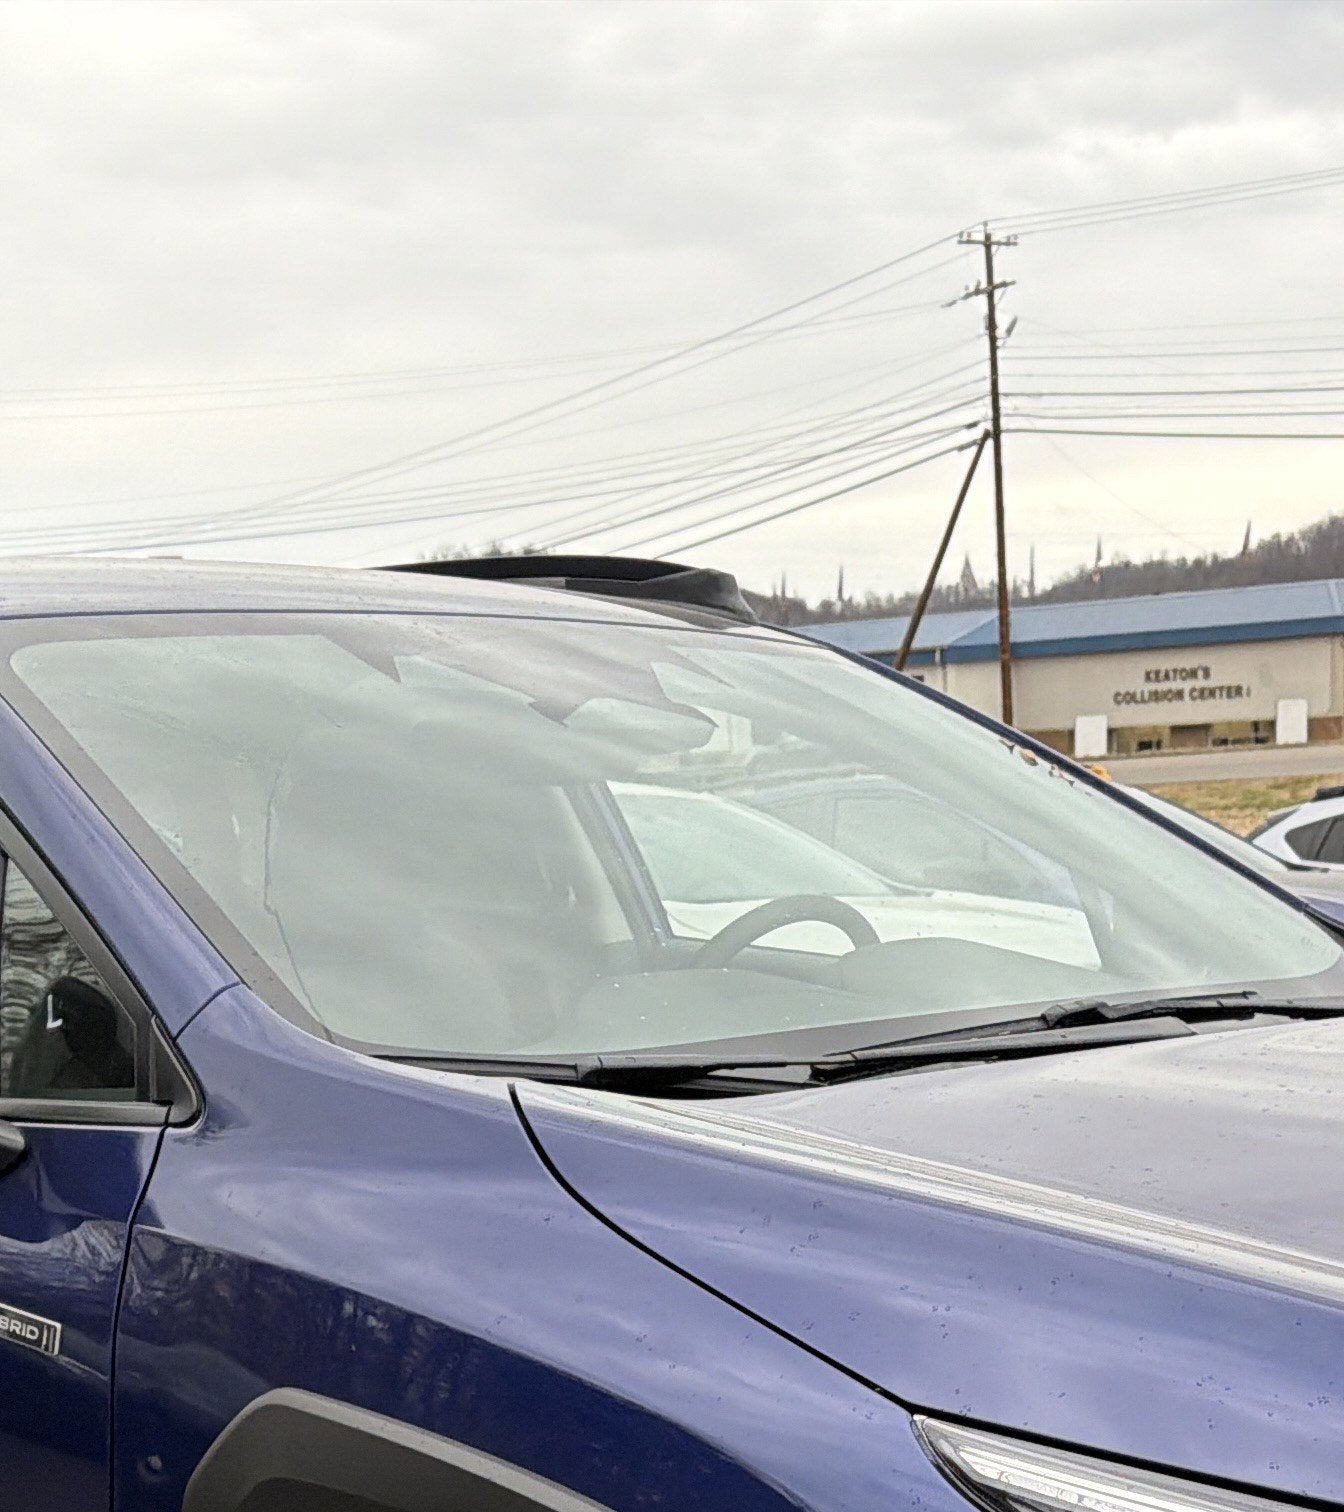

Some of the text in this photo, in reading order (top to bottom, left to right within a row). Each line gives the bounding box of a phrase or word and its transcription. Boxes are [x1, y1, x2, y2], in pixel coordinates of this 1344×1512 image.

[1144, 664, 1211, 683] KEATON'S
[1113, 684, 1244, 705] COLLISION CENTER
